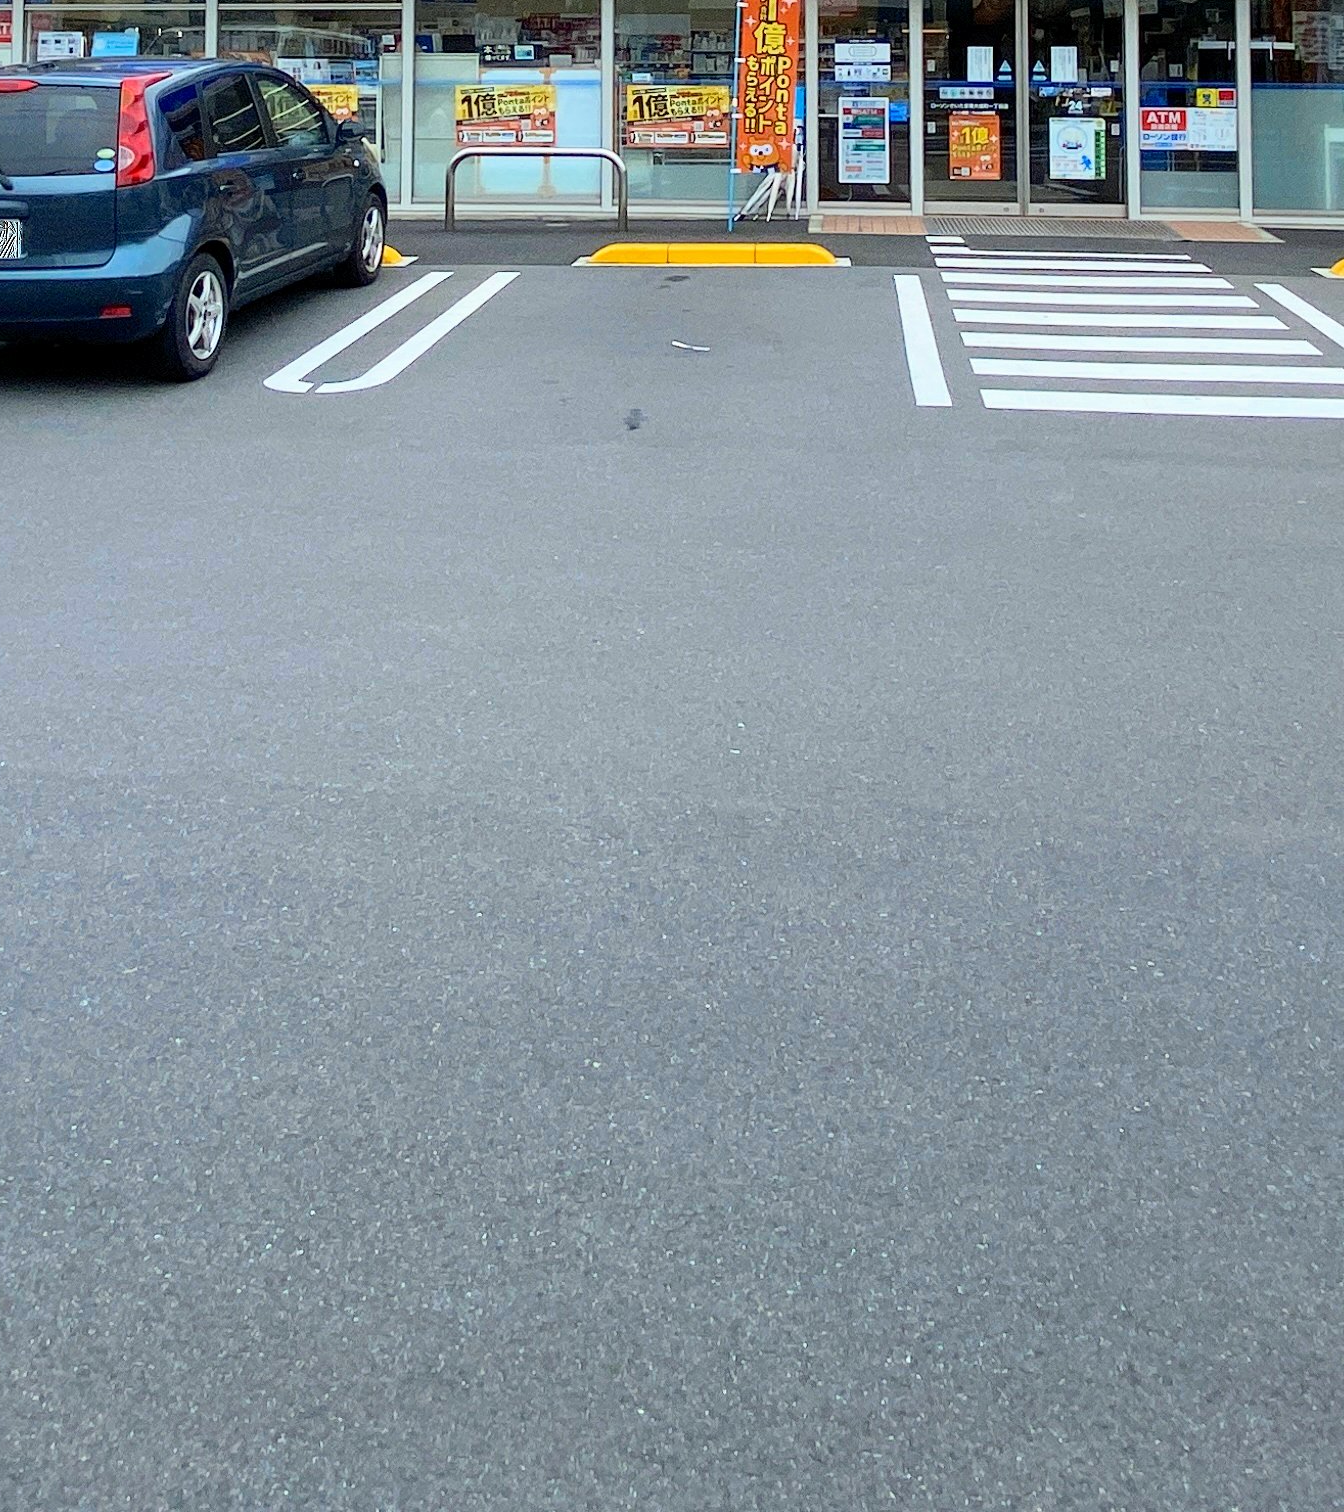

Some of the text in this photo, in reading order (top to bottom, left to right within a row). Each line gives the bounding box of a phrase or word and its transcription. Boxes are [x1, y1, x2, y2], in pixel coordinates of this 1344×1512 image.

[498, 94, 550, 106] Pontaポイント
[670, 95, 724, 107] Pontaポイント
[758, 55, 776, 134] ポイント
[774, 56, 792, 135] Ponta
[461, 93, 498, 119] 1億
[632, 93, 670, 119] 1億
[1068, 100, 1083, 111] 24
[1147, 111, 1182, 124] ATM
